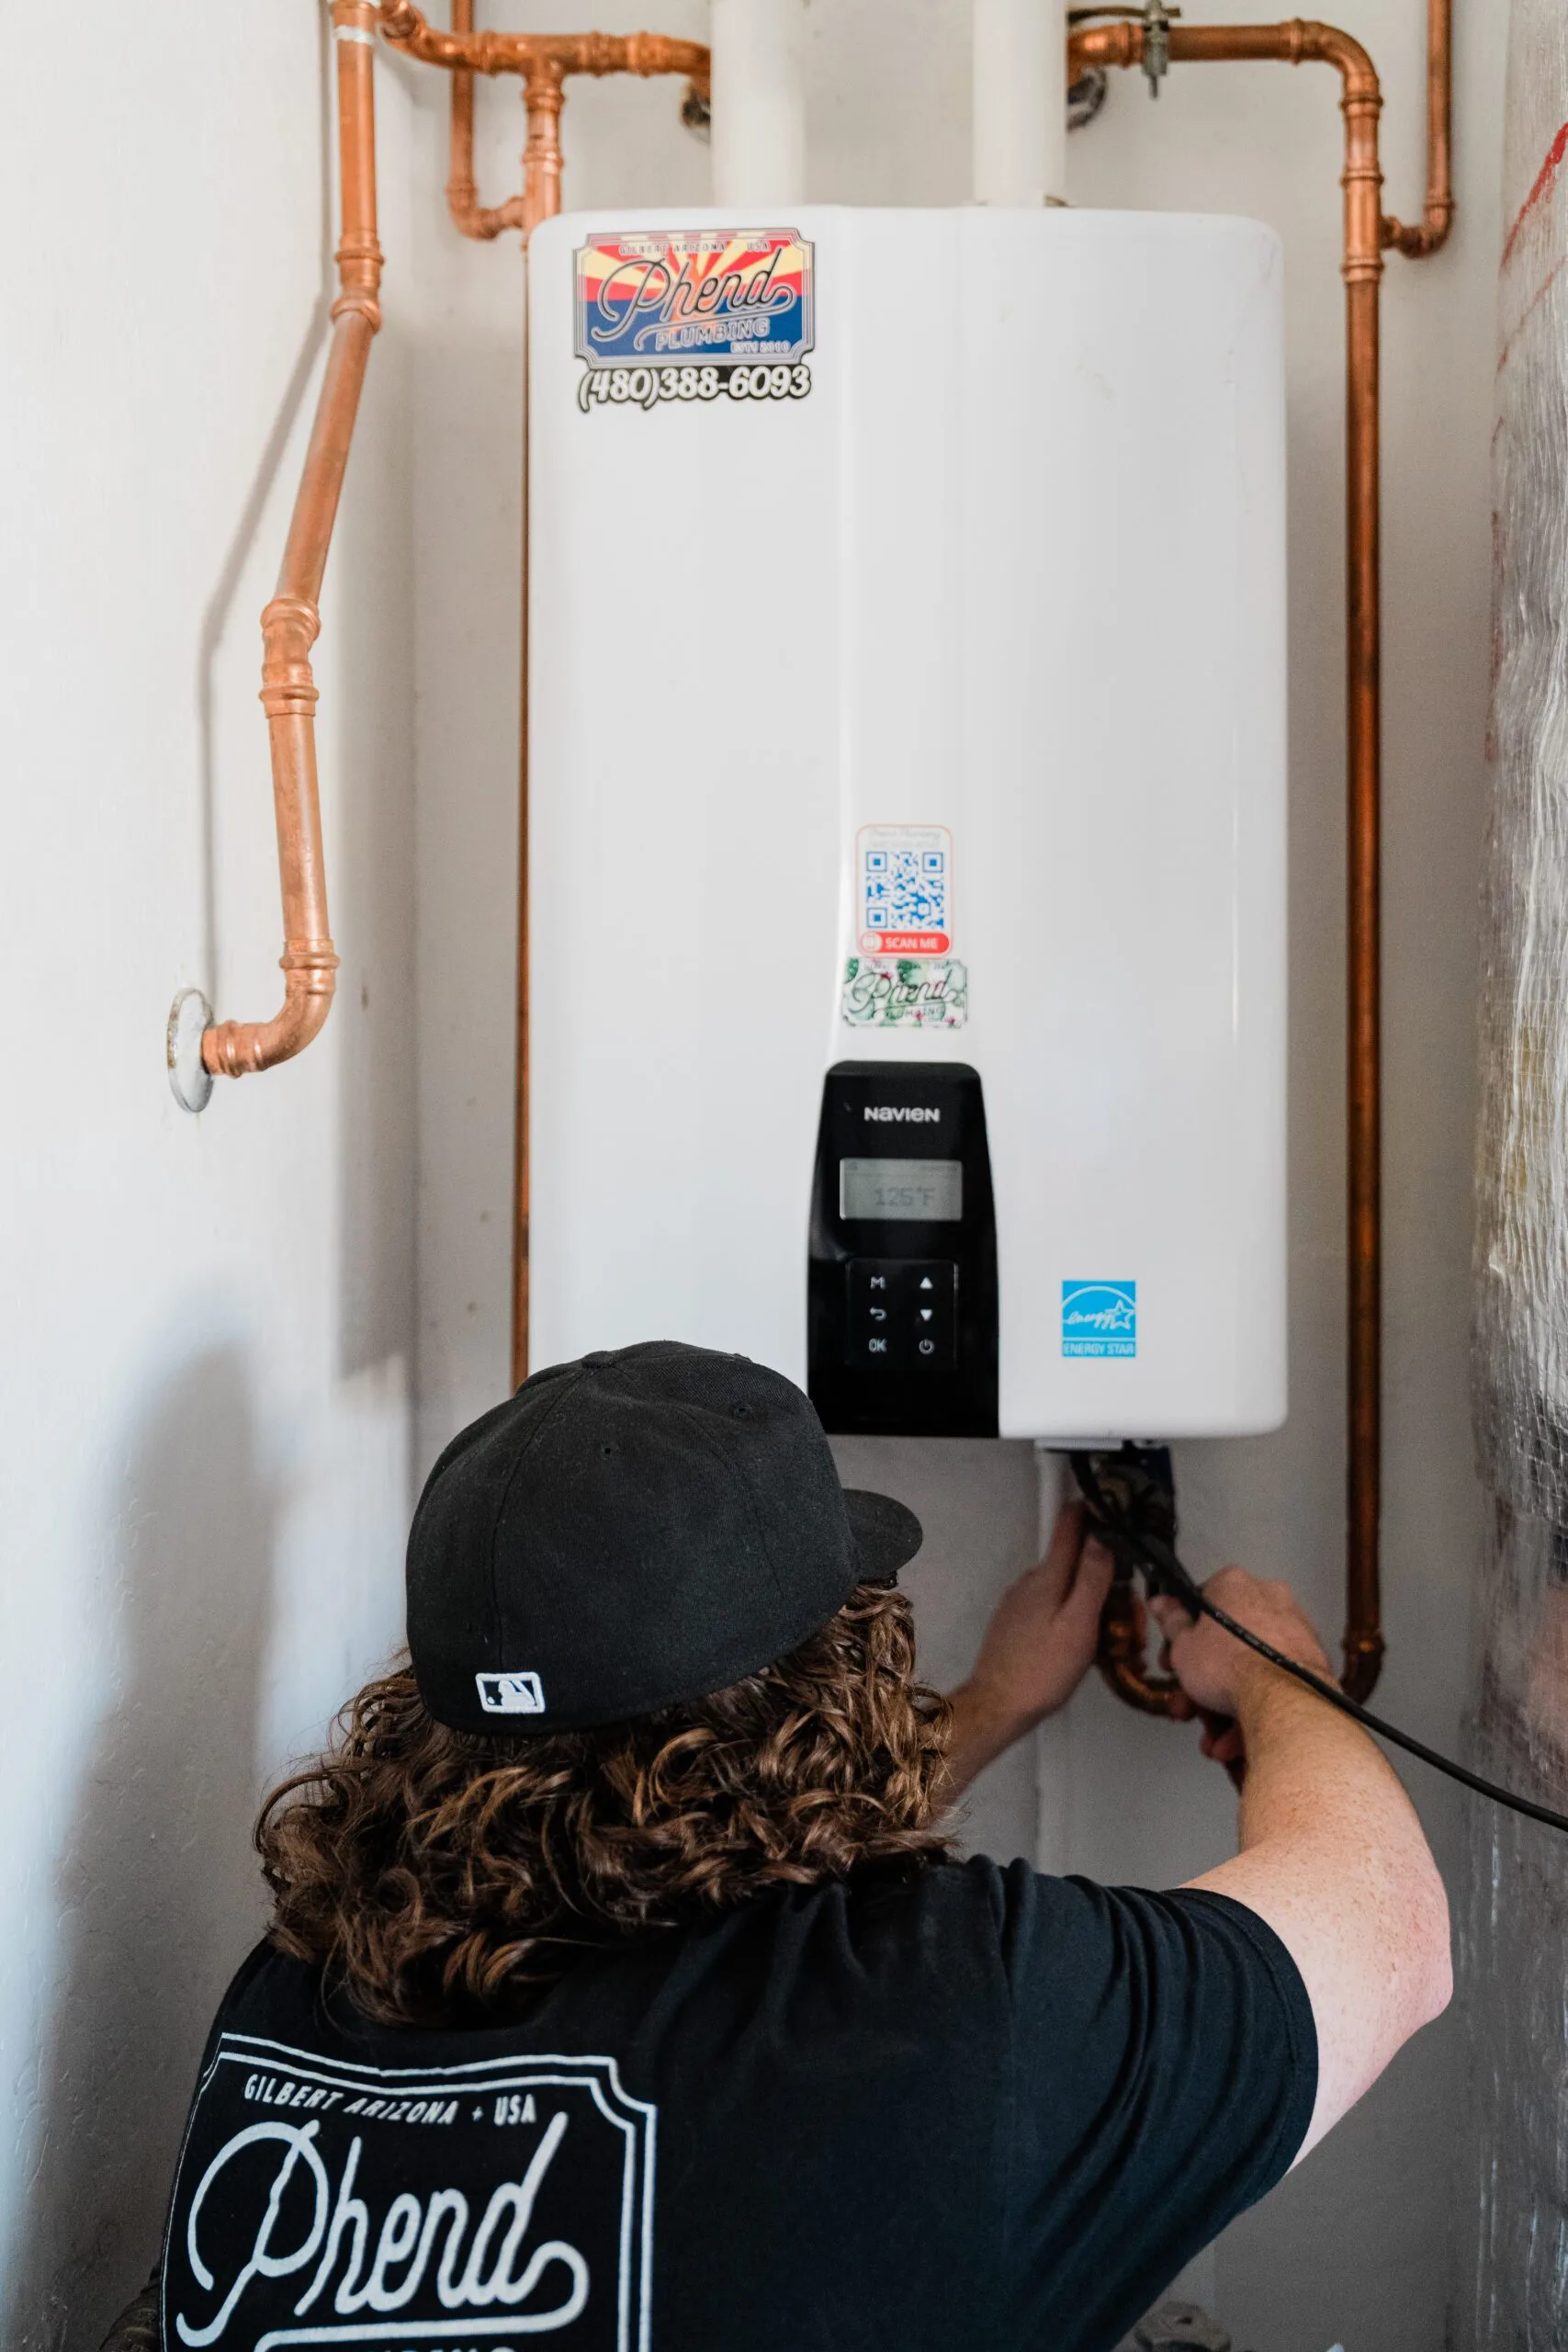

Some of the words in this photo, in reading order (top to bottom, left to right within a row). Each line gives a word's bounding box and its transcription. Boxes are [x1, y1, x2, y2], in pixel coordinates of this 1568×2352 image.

[592, 246, 795, 347] Phend
[655, 317, 771, 351] PLUMBING
[578, 366, 812, 413] (480)388-6093
[885, 936, 918, 950] SCAN
[919, 937, 939, 950] ME
[870, 1276, 886, 1290] M
[868, 1338, 887, 1353] OK
[1107, 1342, 1134, 1355] STAR
[243, 2073, 344, 2110] GILBERT
[342, 2097, 460, 2125] ARIZONA
[493, 2093, 537, 2127] USA
[175, 2111, 589, 2349] Phend
